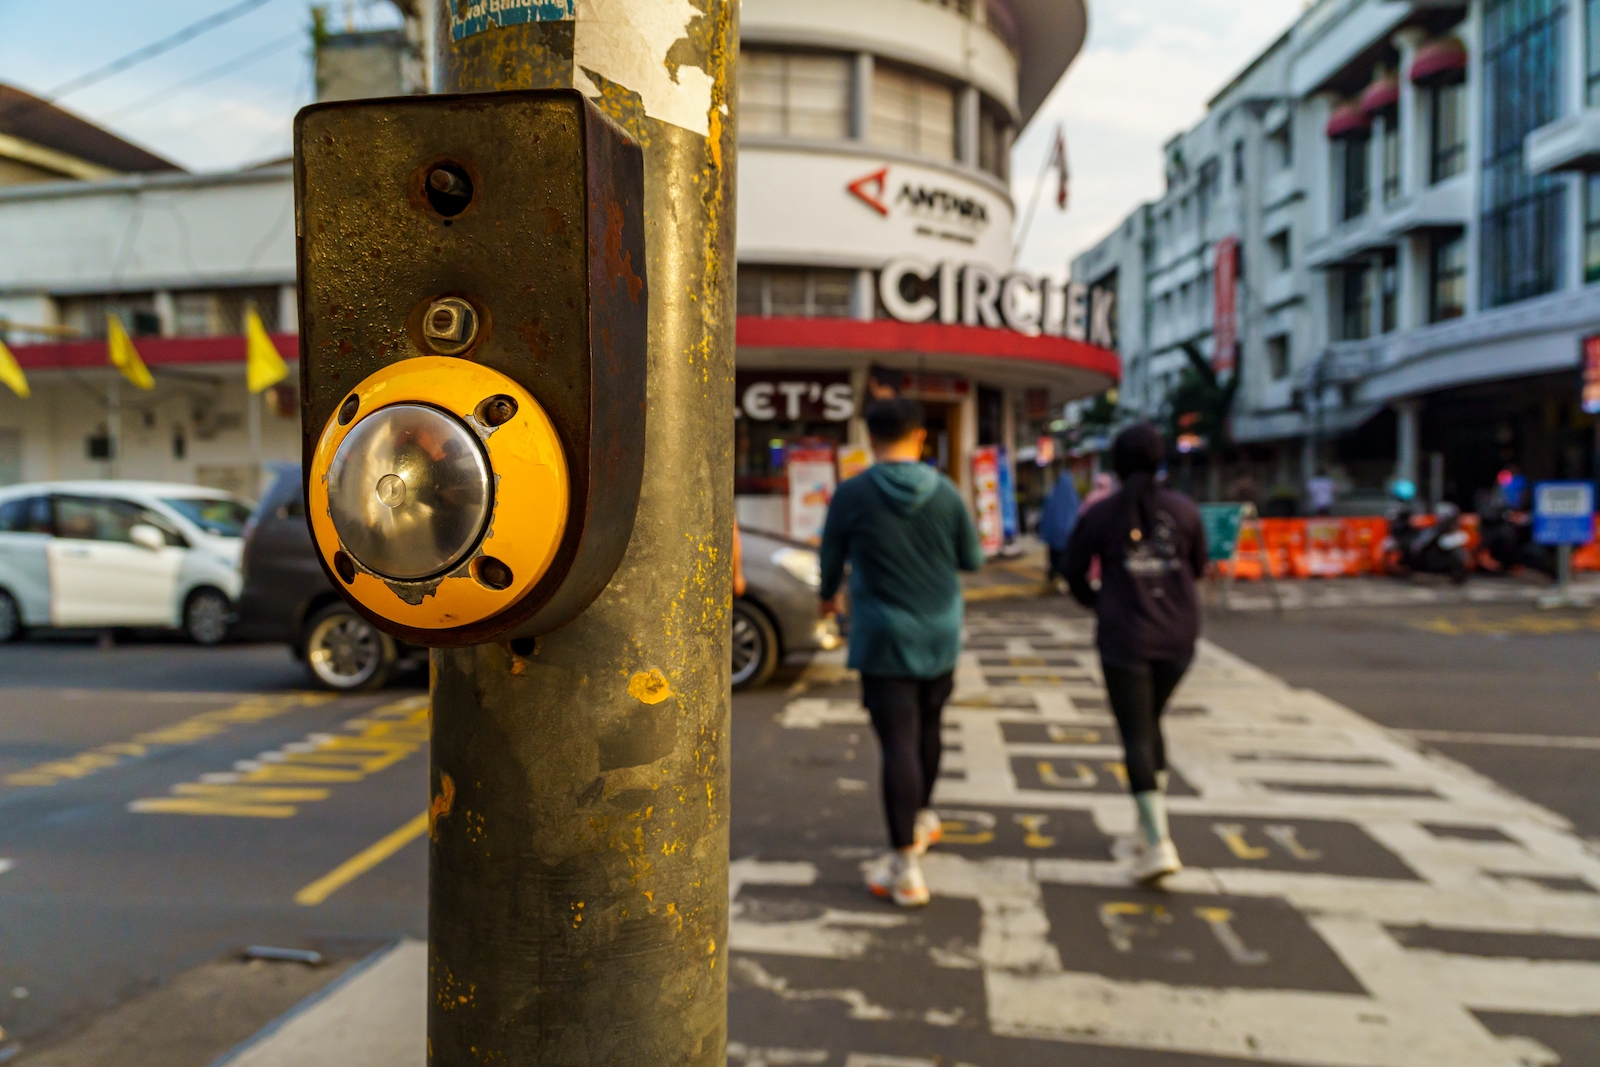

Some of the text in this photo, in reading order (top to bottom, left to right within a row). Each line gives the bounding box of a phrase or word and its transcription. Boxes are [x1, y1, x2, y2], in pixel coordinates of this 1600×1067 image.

[878, 256, 1116, 349] CIRCLE K
[735, 381, 855, 421] ET'S
